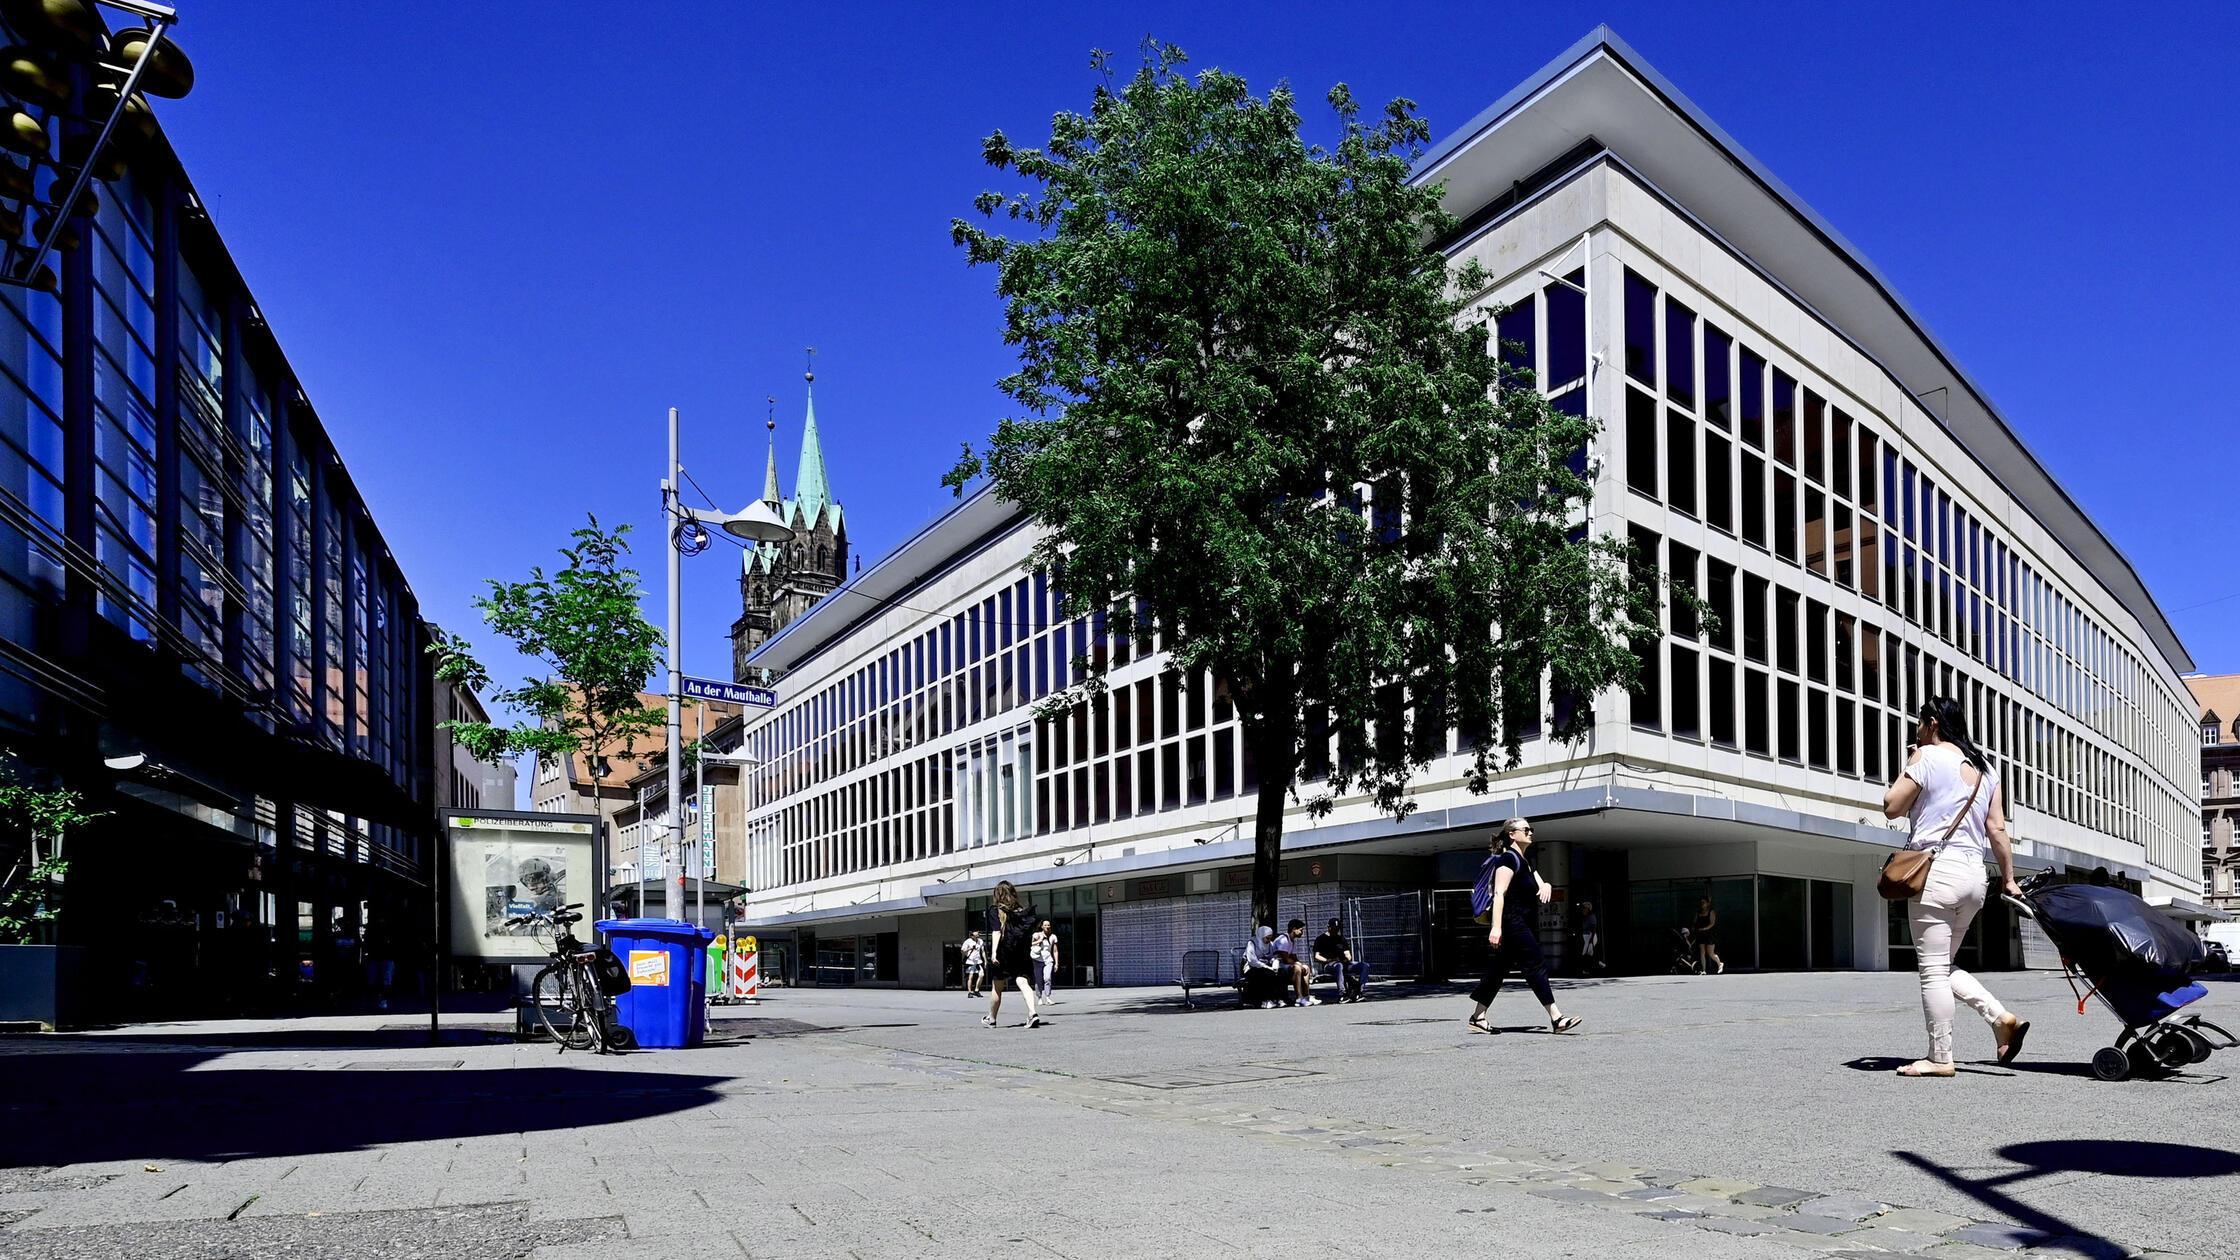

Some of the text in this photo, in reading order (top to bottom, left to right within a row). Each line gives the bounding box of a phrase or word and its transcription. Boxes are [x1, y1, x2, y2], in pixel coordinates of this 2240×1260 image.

[687, 681, 773, 705] An der Mauthalle
